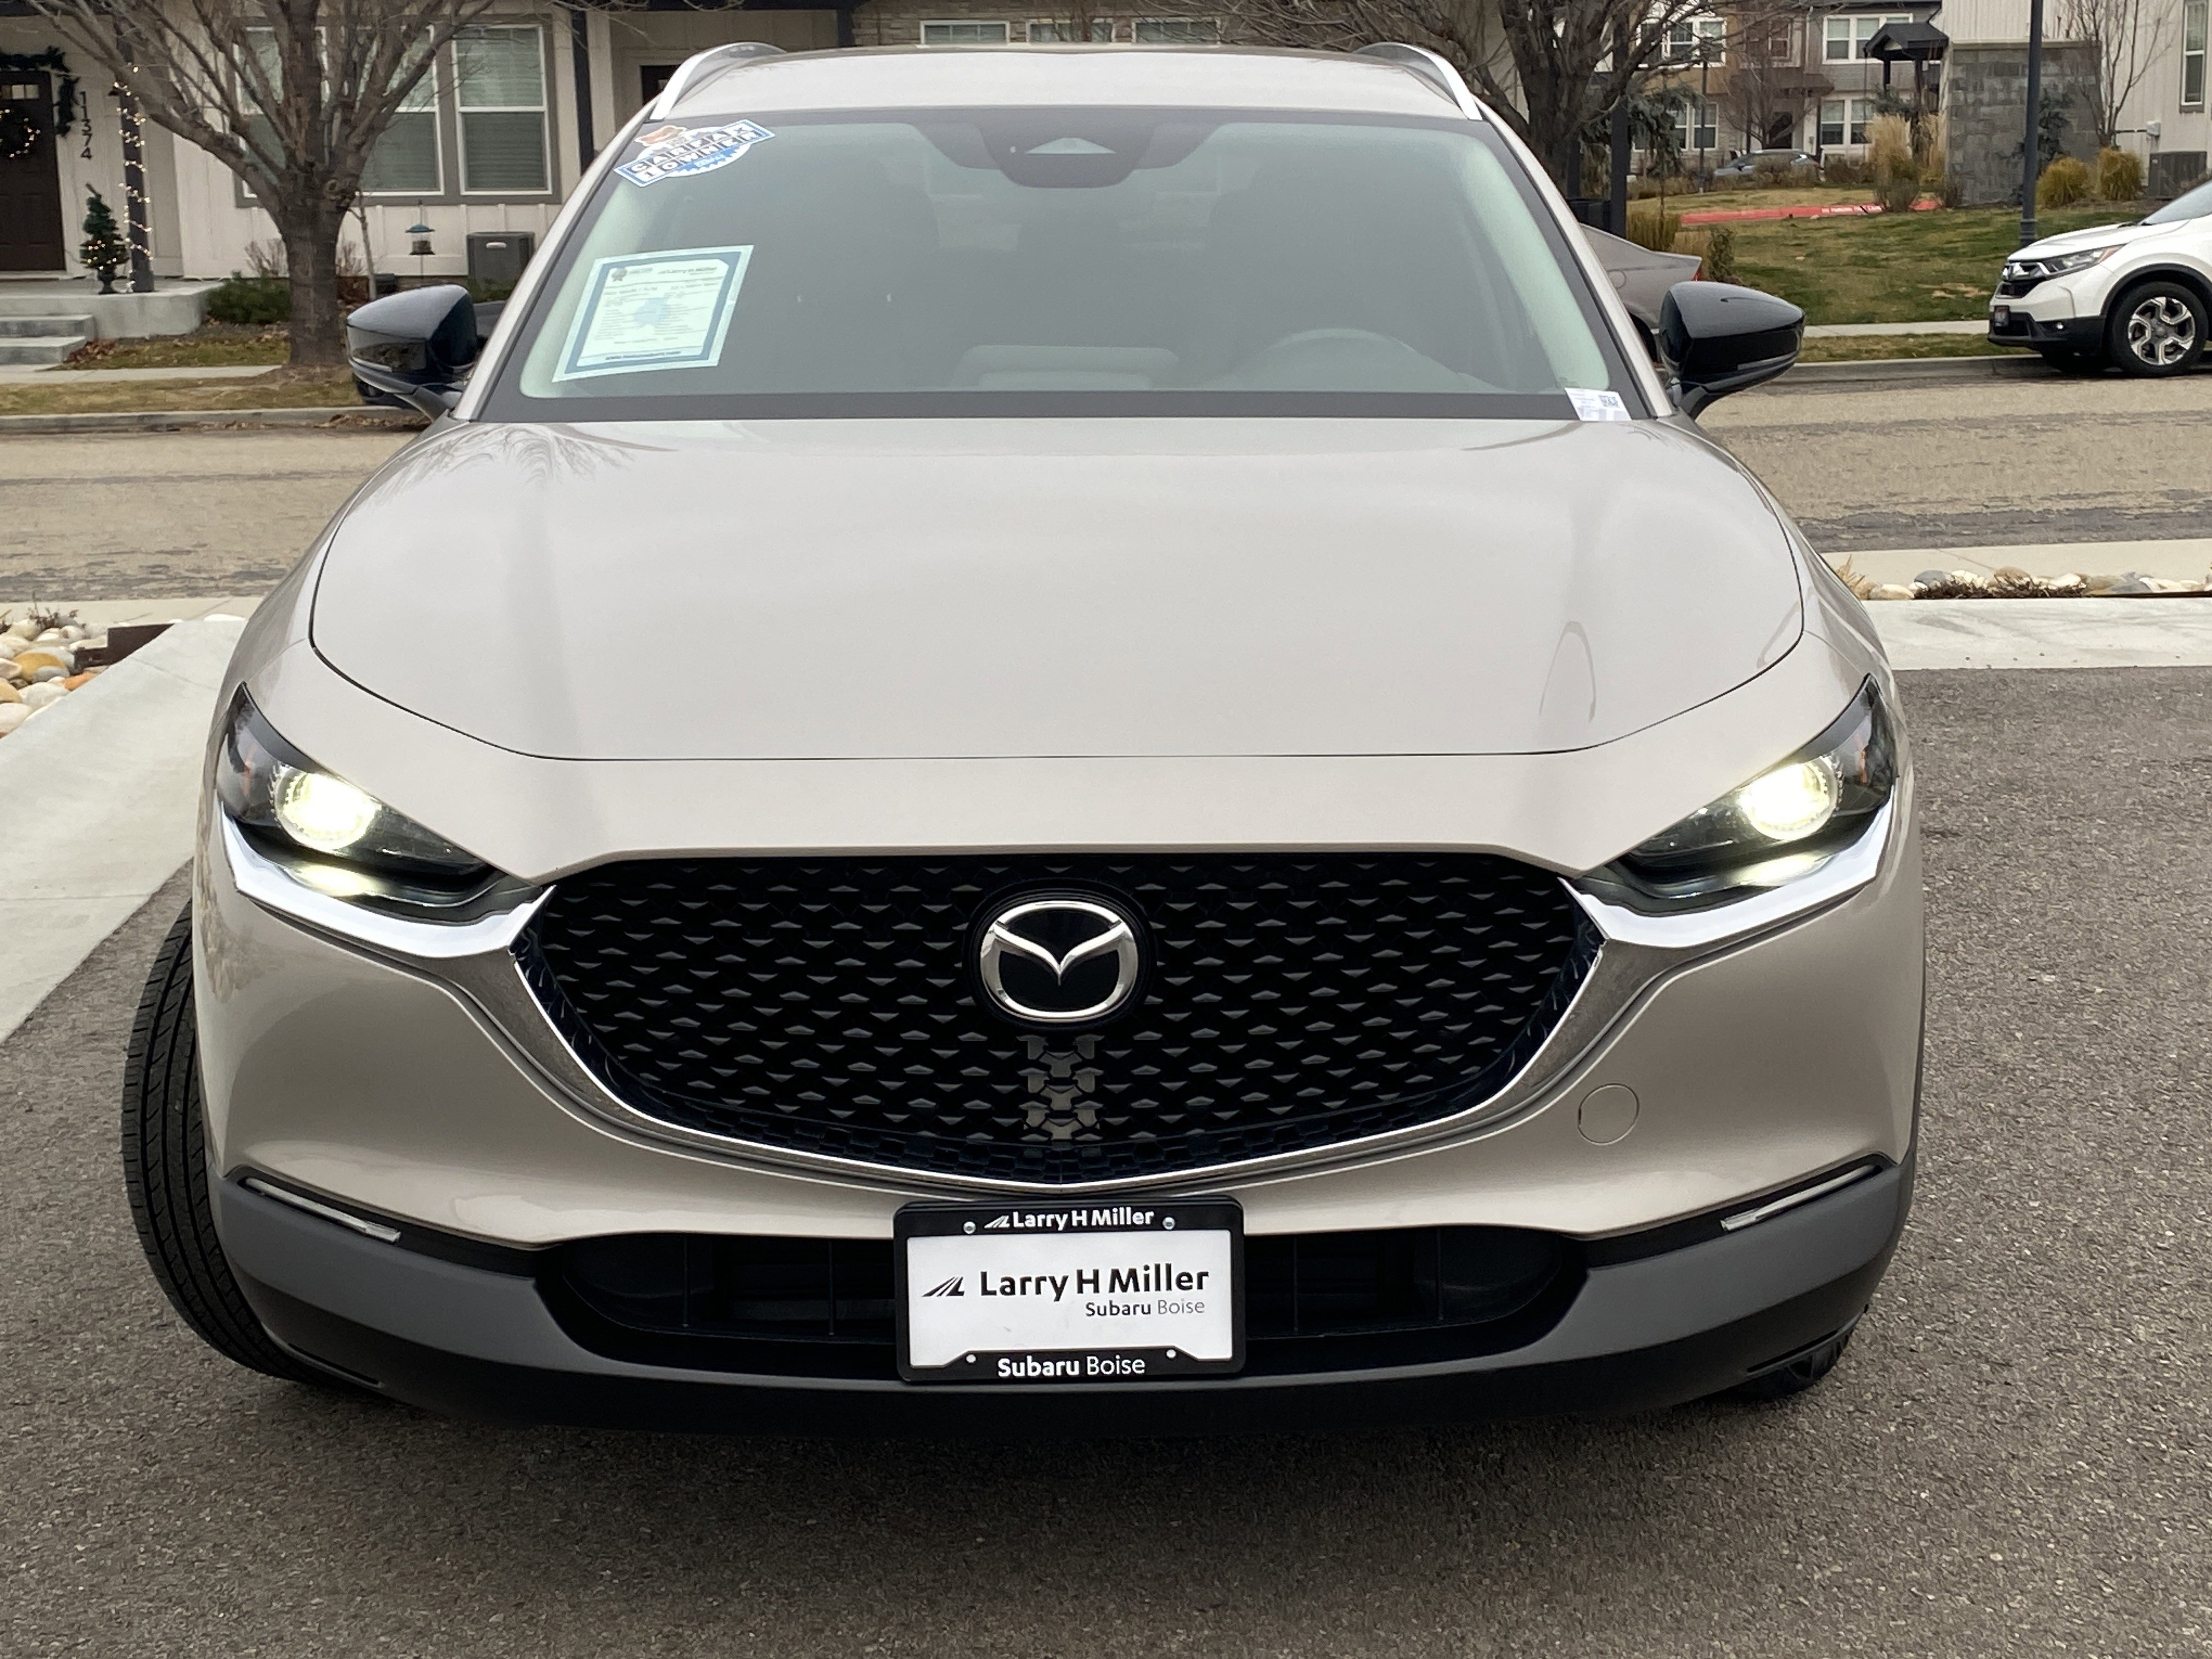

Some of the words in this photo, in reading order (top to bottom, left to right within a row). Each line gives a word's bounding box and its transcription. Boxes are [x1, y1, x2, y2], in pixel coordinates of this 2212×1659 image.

[79, 91, 93, 160] 11374
[630, 127, 747, 173] CARFAX
[1013, 1211, 1069, 1231] Larry
[1071, 1210, 1087, 1226] H
[1091, 1206, 1154, 1226] Miller
[980, 1271, 1069, 1302] Larry
[1076, 1269, 1099, 1294] H
[1109, 1263, 1209, 1293] Miller
[1086, 1300, 1152, 1317] Subaru
[1158, 1298, 1206, 1314] Boise
[997, 1355, 1080, 1377] Subaru
[1086, 1355, 1146, 1375] Boise
